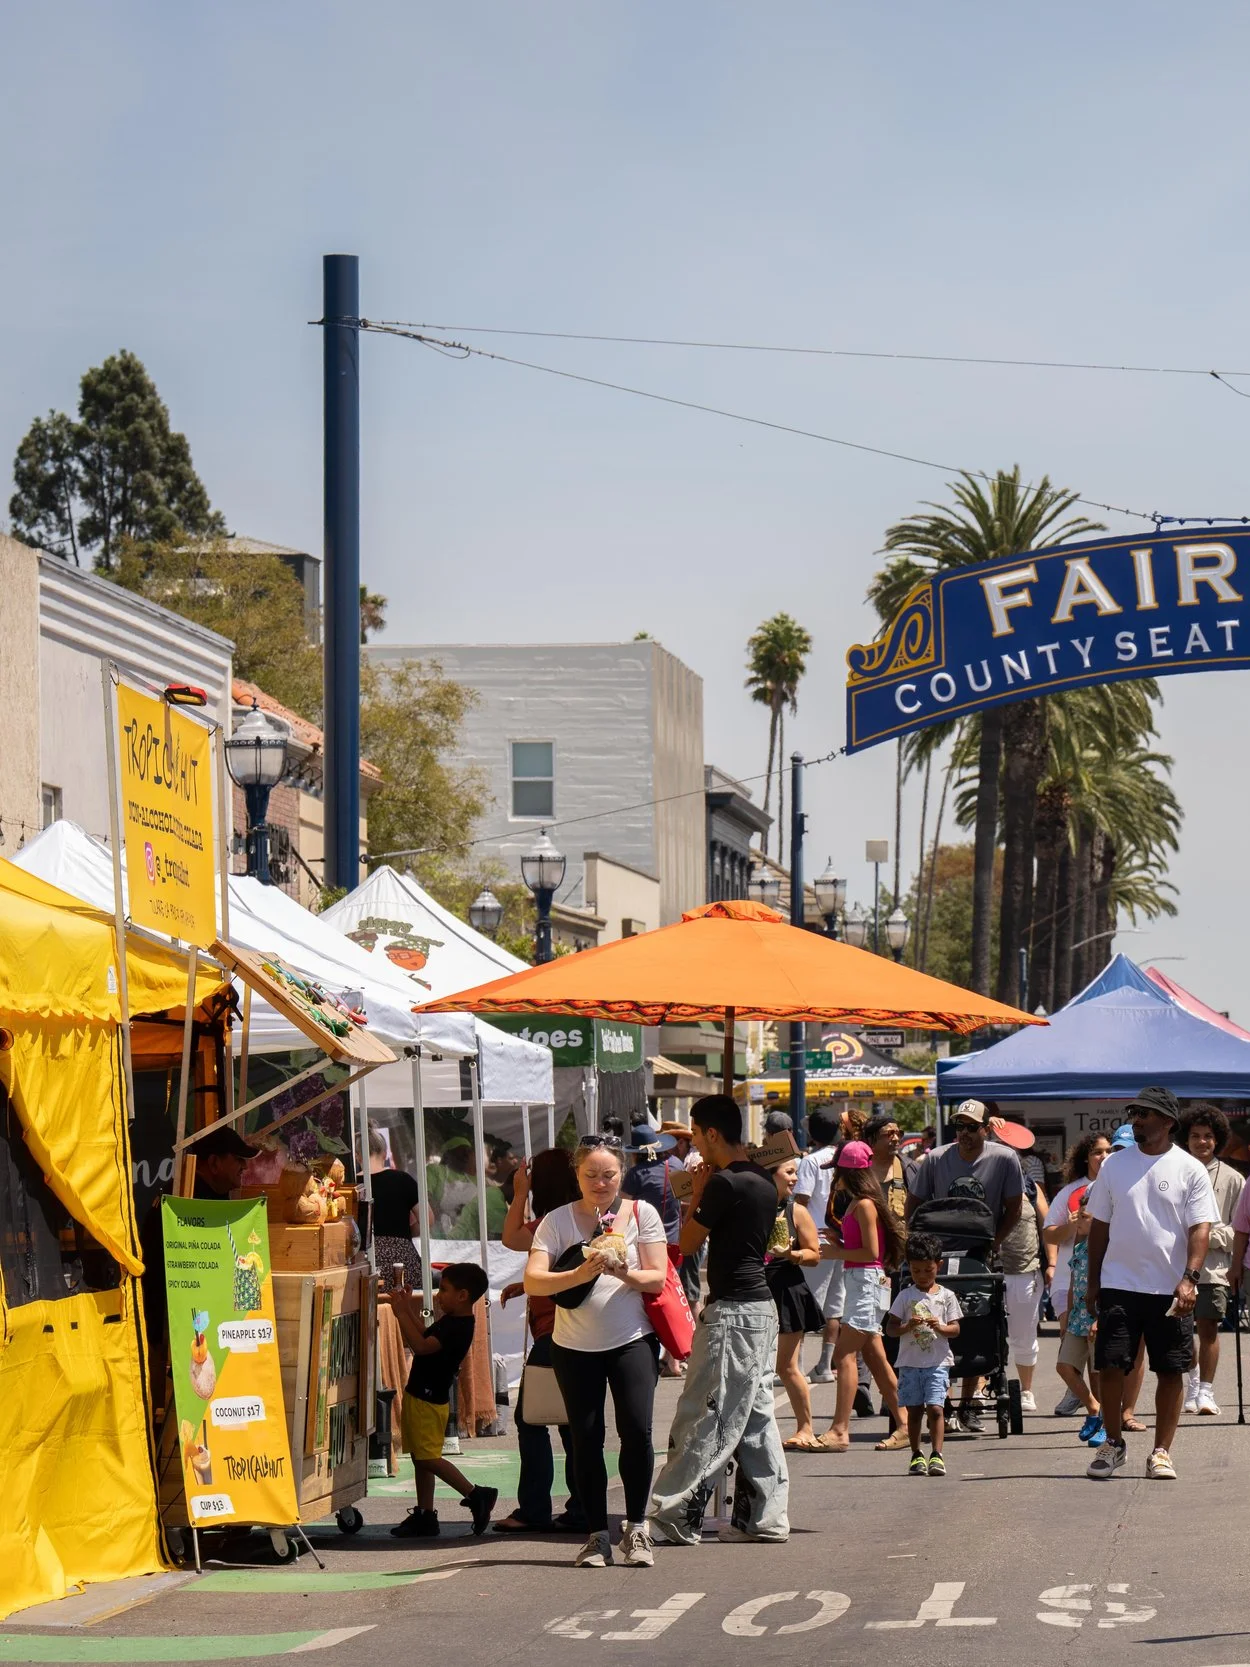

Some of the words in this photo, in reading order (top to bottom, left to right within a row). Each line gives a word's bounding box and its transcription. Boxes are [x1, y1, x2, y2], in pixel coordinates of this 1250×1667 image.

[894, 636, 1095, 715] COUNTY
[1115, 618, 1240, 662] SEAT
[866, 1035, 880, 1045] ONE
[883, 1035, 898, 1045] WAY
[176, 1216, 205, 1228] FLAVORS
[166, 1240, 188, 1249] ORIGINAL
[188, 1239, 200, 1250] PIÑA
[200, 1241, 221, 1250] COLADA
[167, 1260, 198, 1269] STRAWBERRY
[198, 1261, 219, 1270] COLADA
[168, 1280, 180, 1289] SPICY
[180, 1280, 201, 1289] COLADA
[221, 1329, 257, 1340] PINEAPPLE
[257, 1327, 272, 1339] $17
[215, 1406, 246, 1417] COCONUT
[246, 1404, 261, 1417] $17
[200, 1500, 212, 1511] CUP
